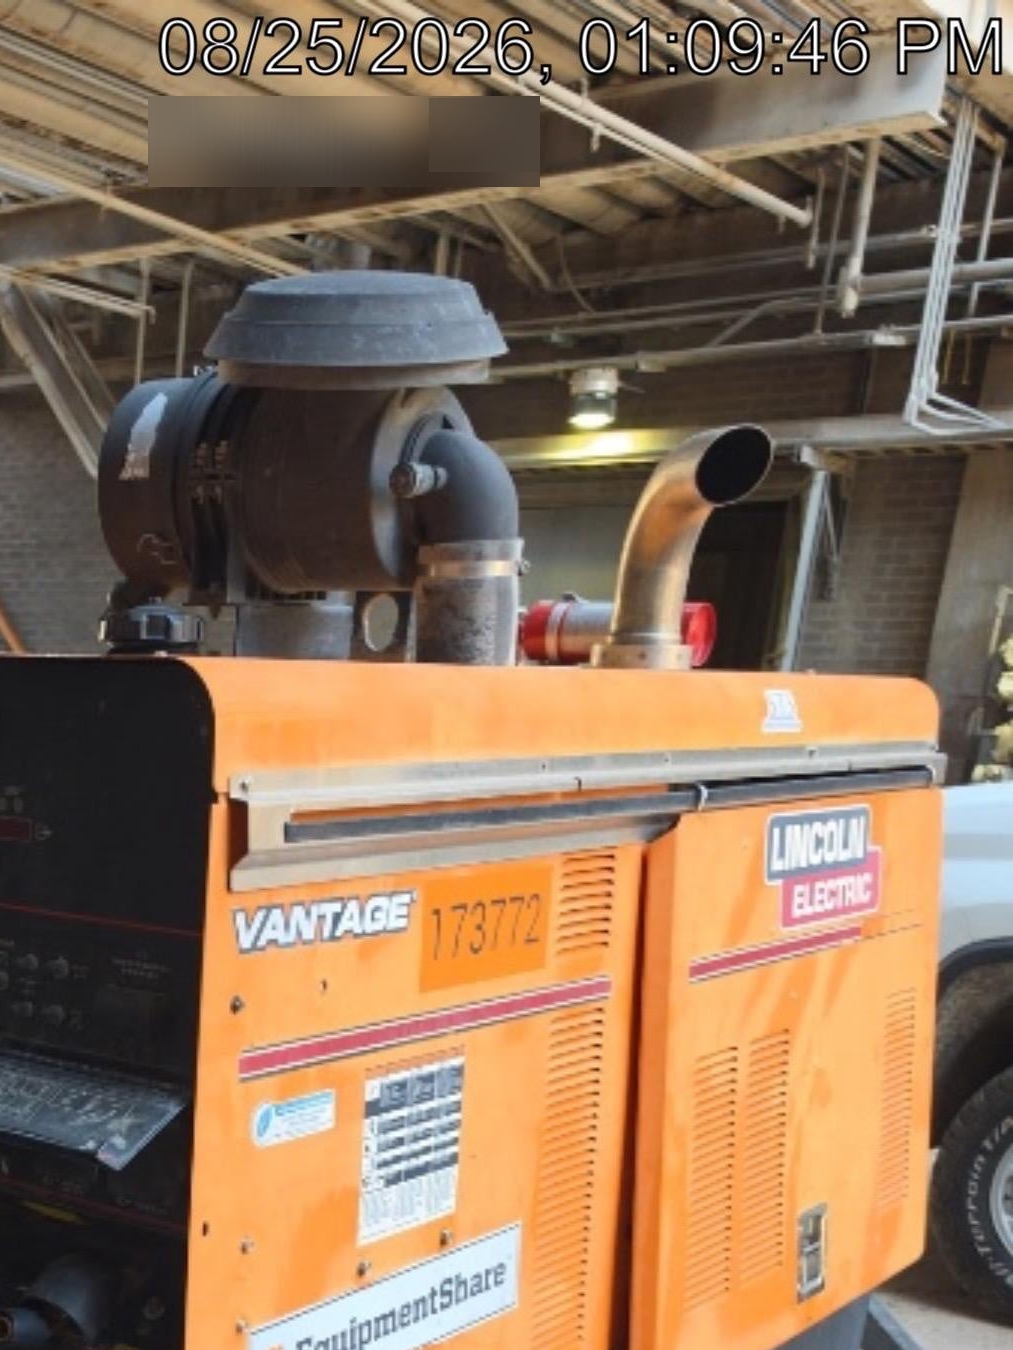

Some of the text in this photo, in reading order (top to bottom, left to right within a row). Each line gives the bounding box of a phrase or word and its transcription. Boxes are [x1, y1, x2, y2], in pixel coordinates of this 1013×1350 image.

[770, 814, 868, 872] LINCOLN
[233, 890, 415, 952] VANTAGE
[790, 871, 874, 919] ELECTRIC
[431, 893, 541, 961] 173772
